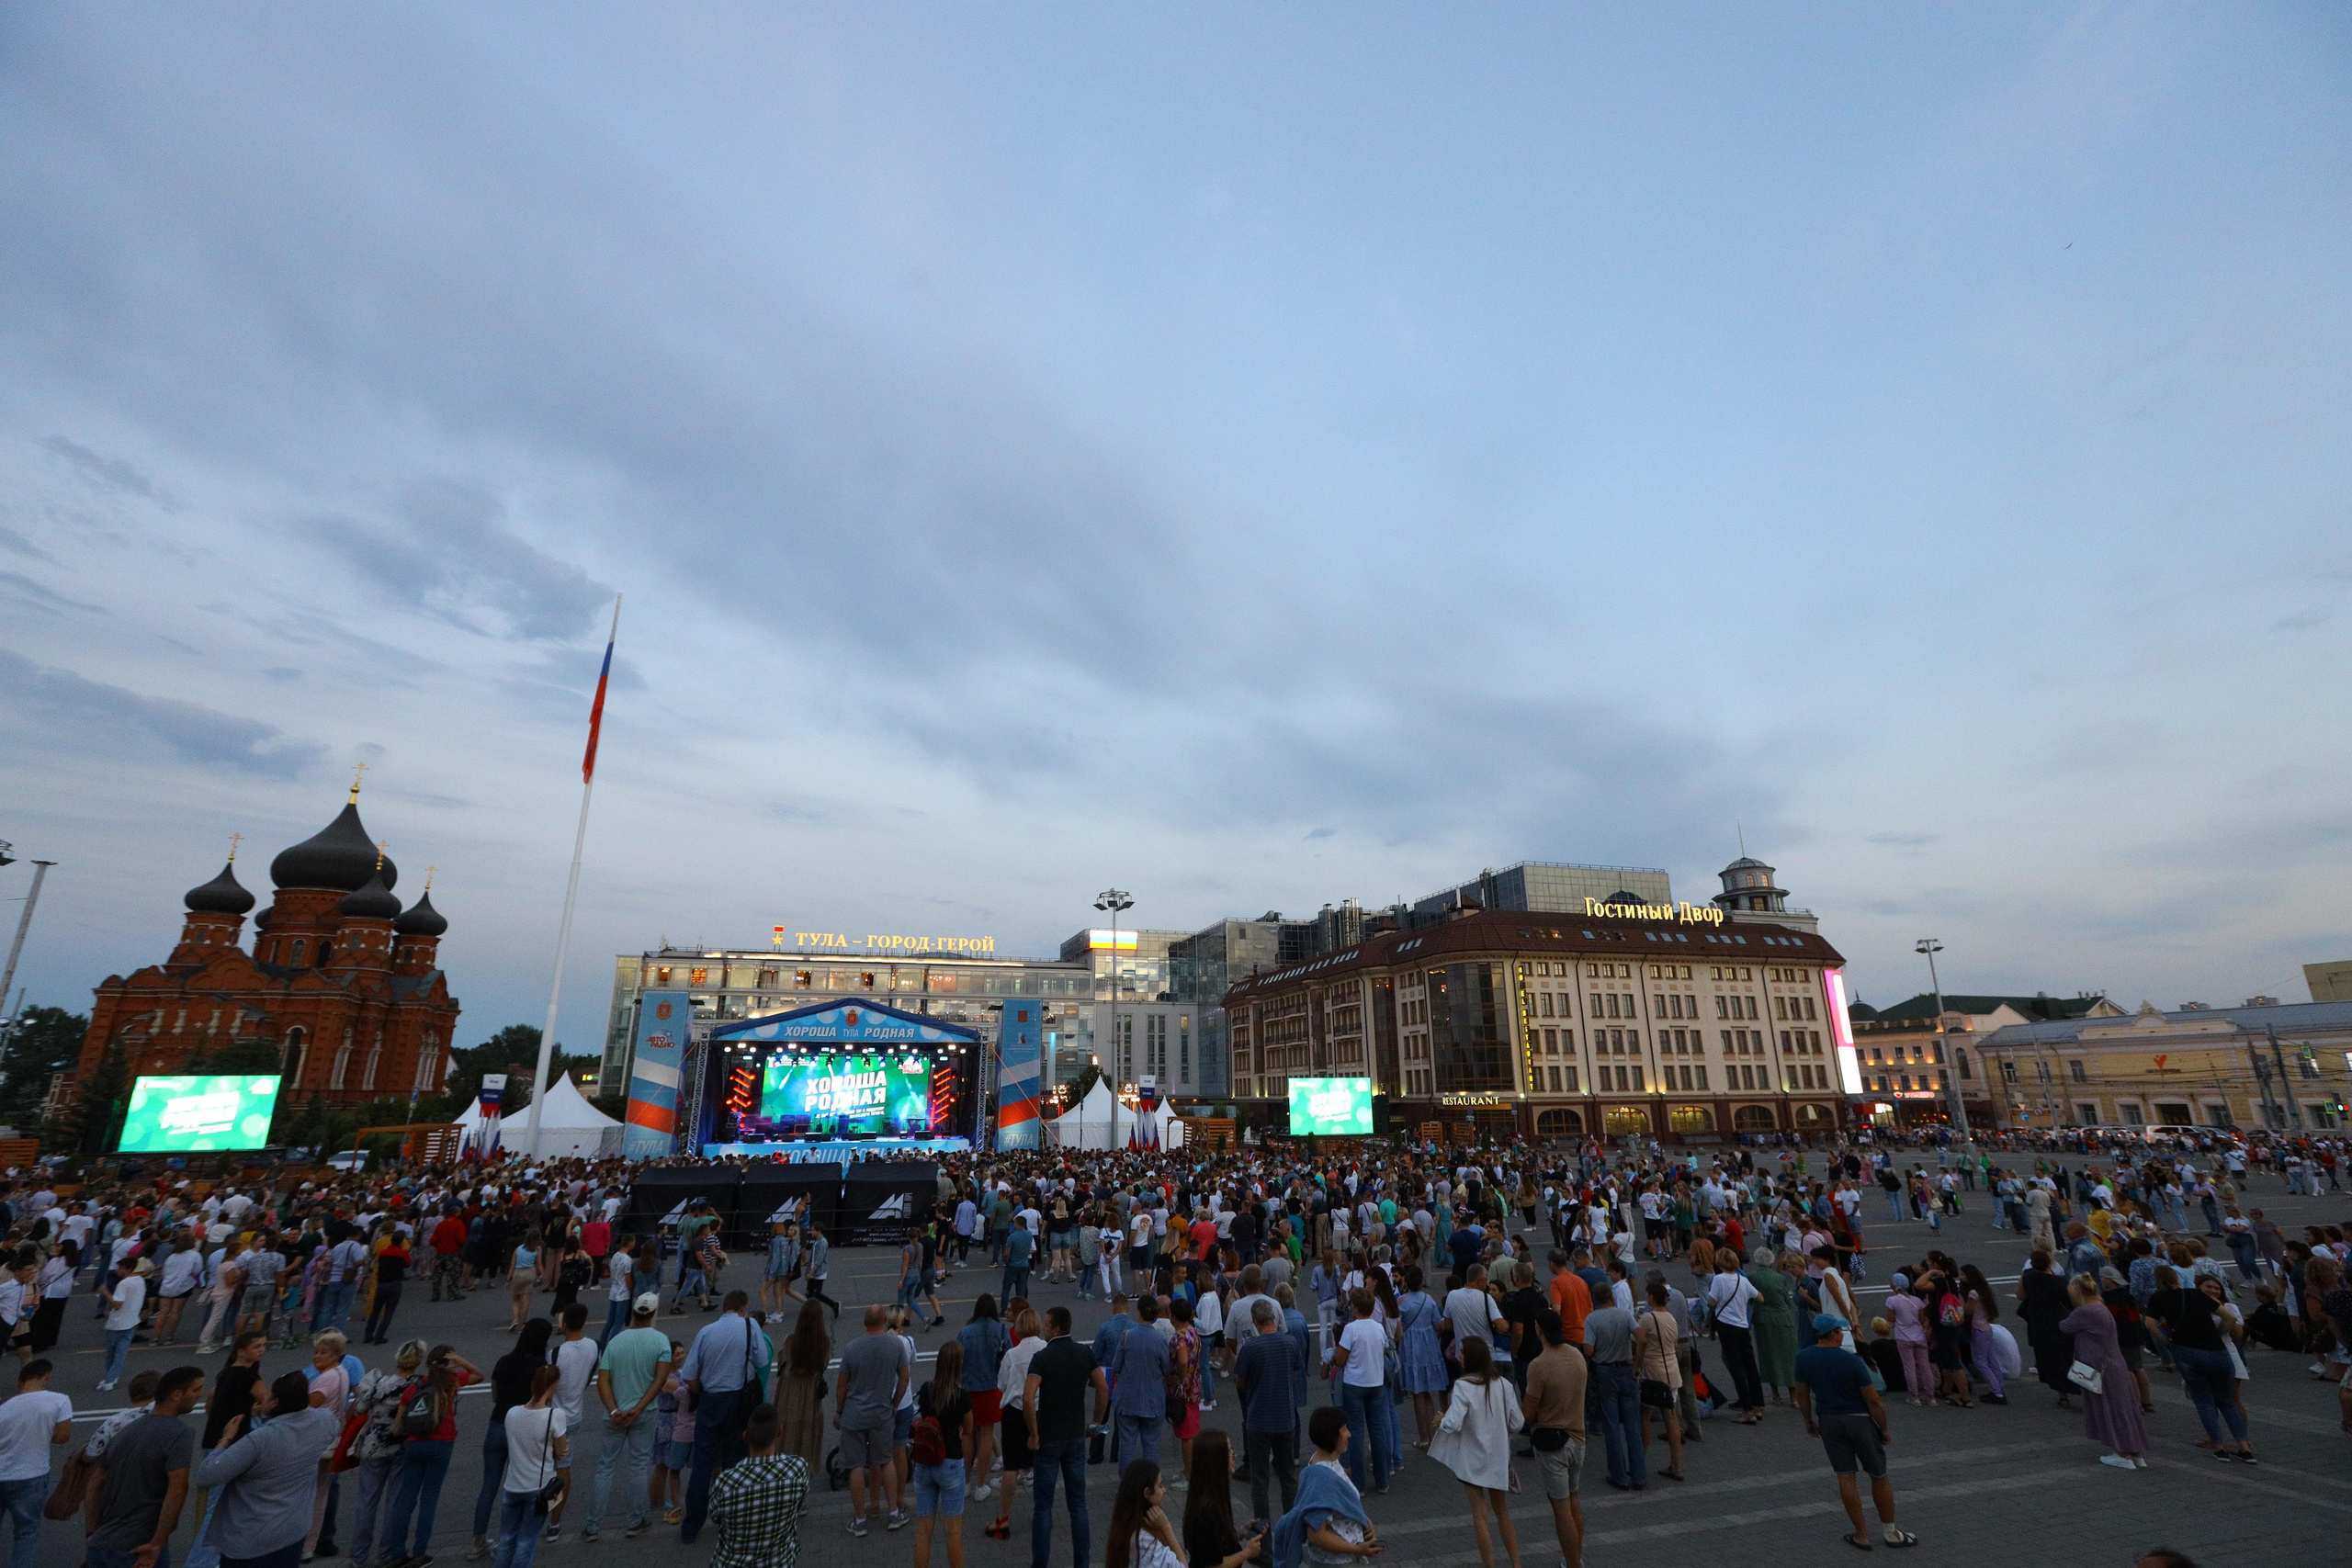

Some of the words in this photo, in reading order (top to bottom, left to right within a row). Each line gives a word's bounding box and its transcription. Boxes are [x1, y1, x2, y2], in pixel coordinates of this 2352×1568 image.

[1584, 897, 1674, 920] Гостиный
[1679, 901, 1724, 927] Двор
[795, 932, 848, 947] ТУЛА
[866, 935, 995, 952] ГОРОД-ГЕРОЙ
[785, 1026, 837, 1037] ХОРОША
[842, 1028, 859, 1038] ТУЛА
[865, 1028, 915, 1039] РОДНАЯ
[806, 1070, 888, 1096] ХОРОША
[804, 1087, 887, 1112] РОДНАЯ
[1442, 1097, 1499, 1106] RESTAURANT
[628, 1139, 664, 1155] #ТУЛА
[1003, 1134, 1034, 1147] #ТУЛА
